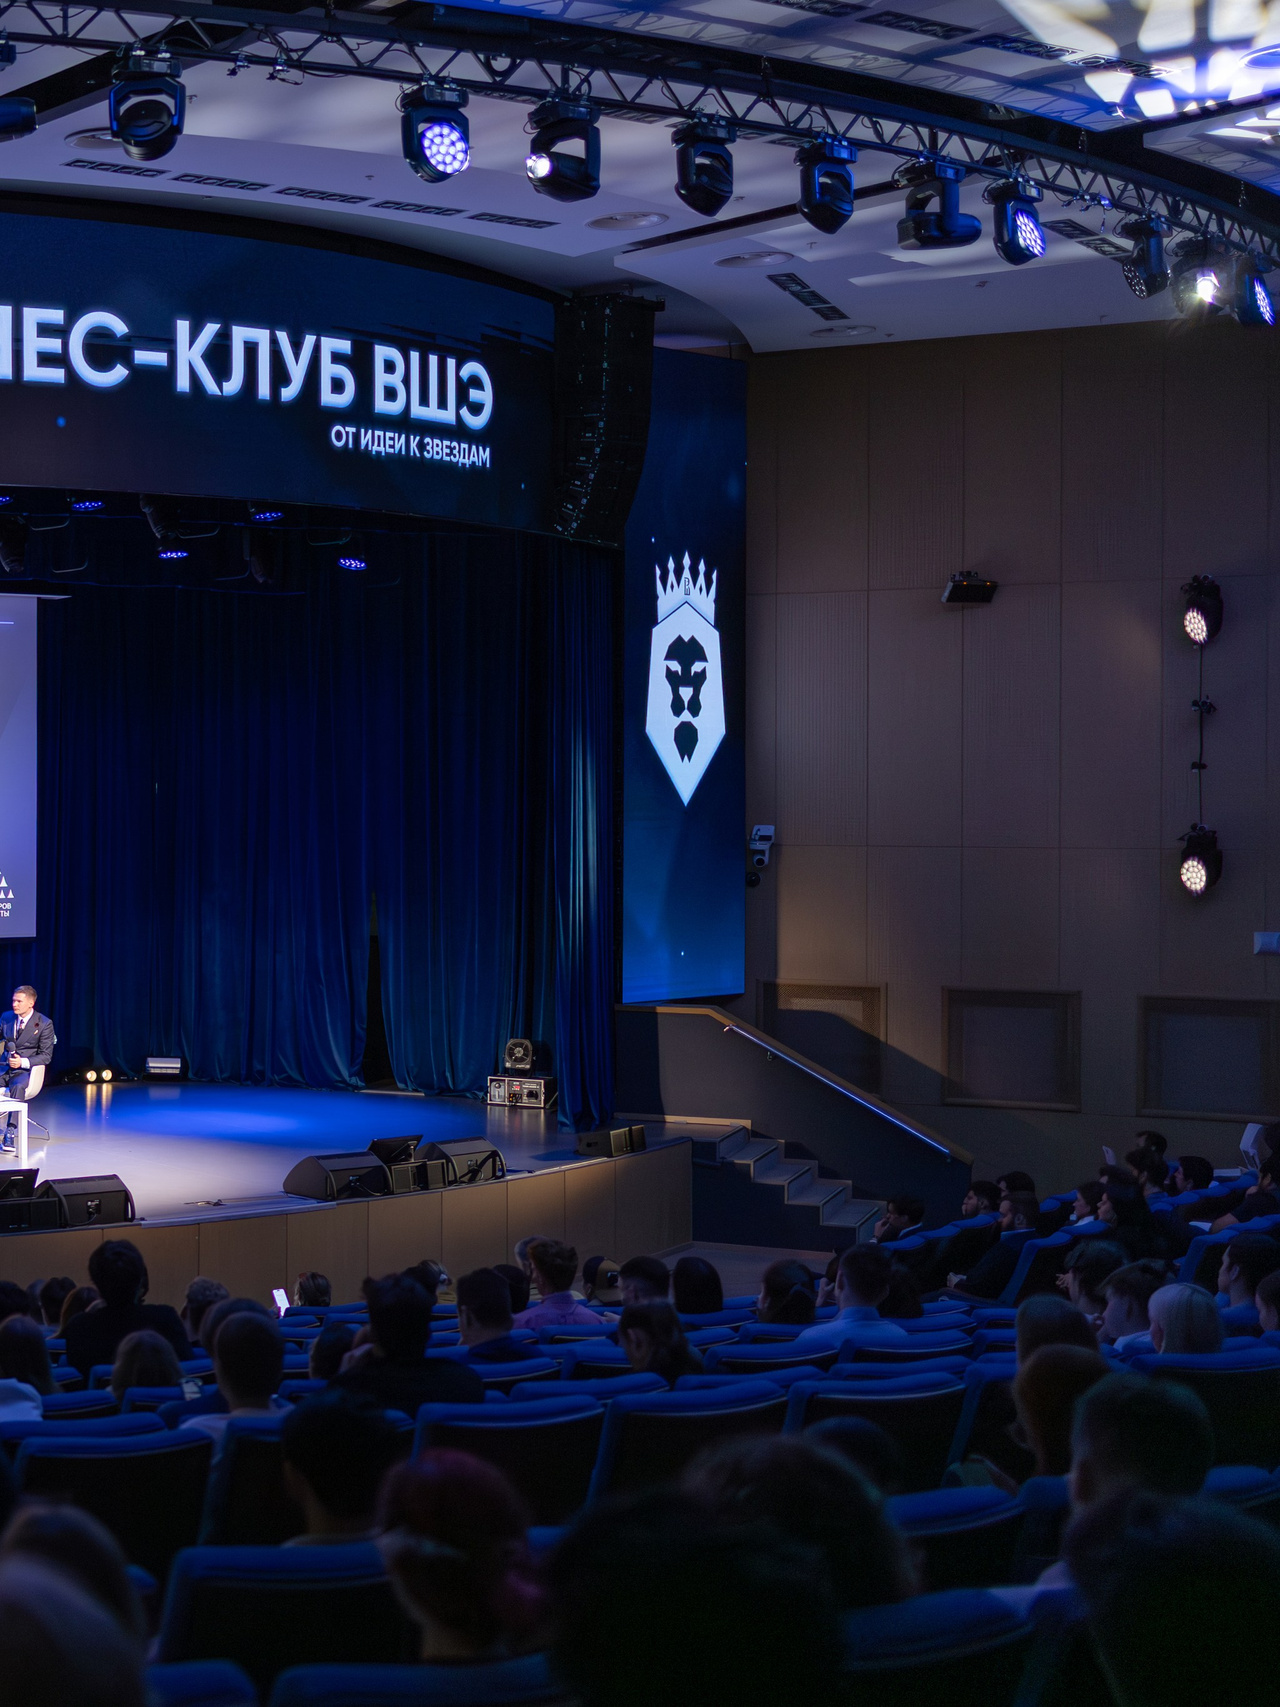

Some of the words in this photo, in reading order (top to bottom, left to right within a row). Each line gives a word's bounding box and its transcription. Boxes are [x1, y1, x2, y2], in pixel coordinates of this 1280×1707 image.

[373, 344, 493, 430] ВШЭ
[331, 425, 356, 448] ОТ
[360, 428, 406, 456] ИДЕИ
[410, 435, 420, 457] К
[423, 437, 490, 468] ЗВЕЗДАМ
